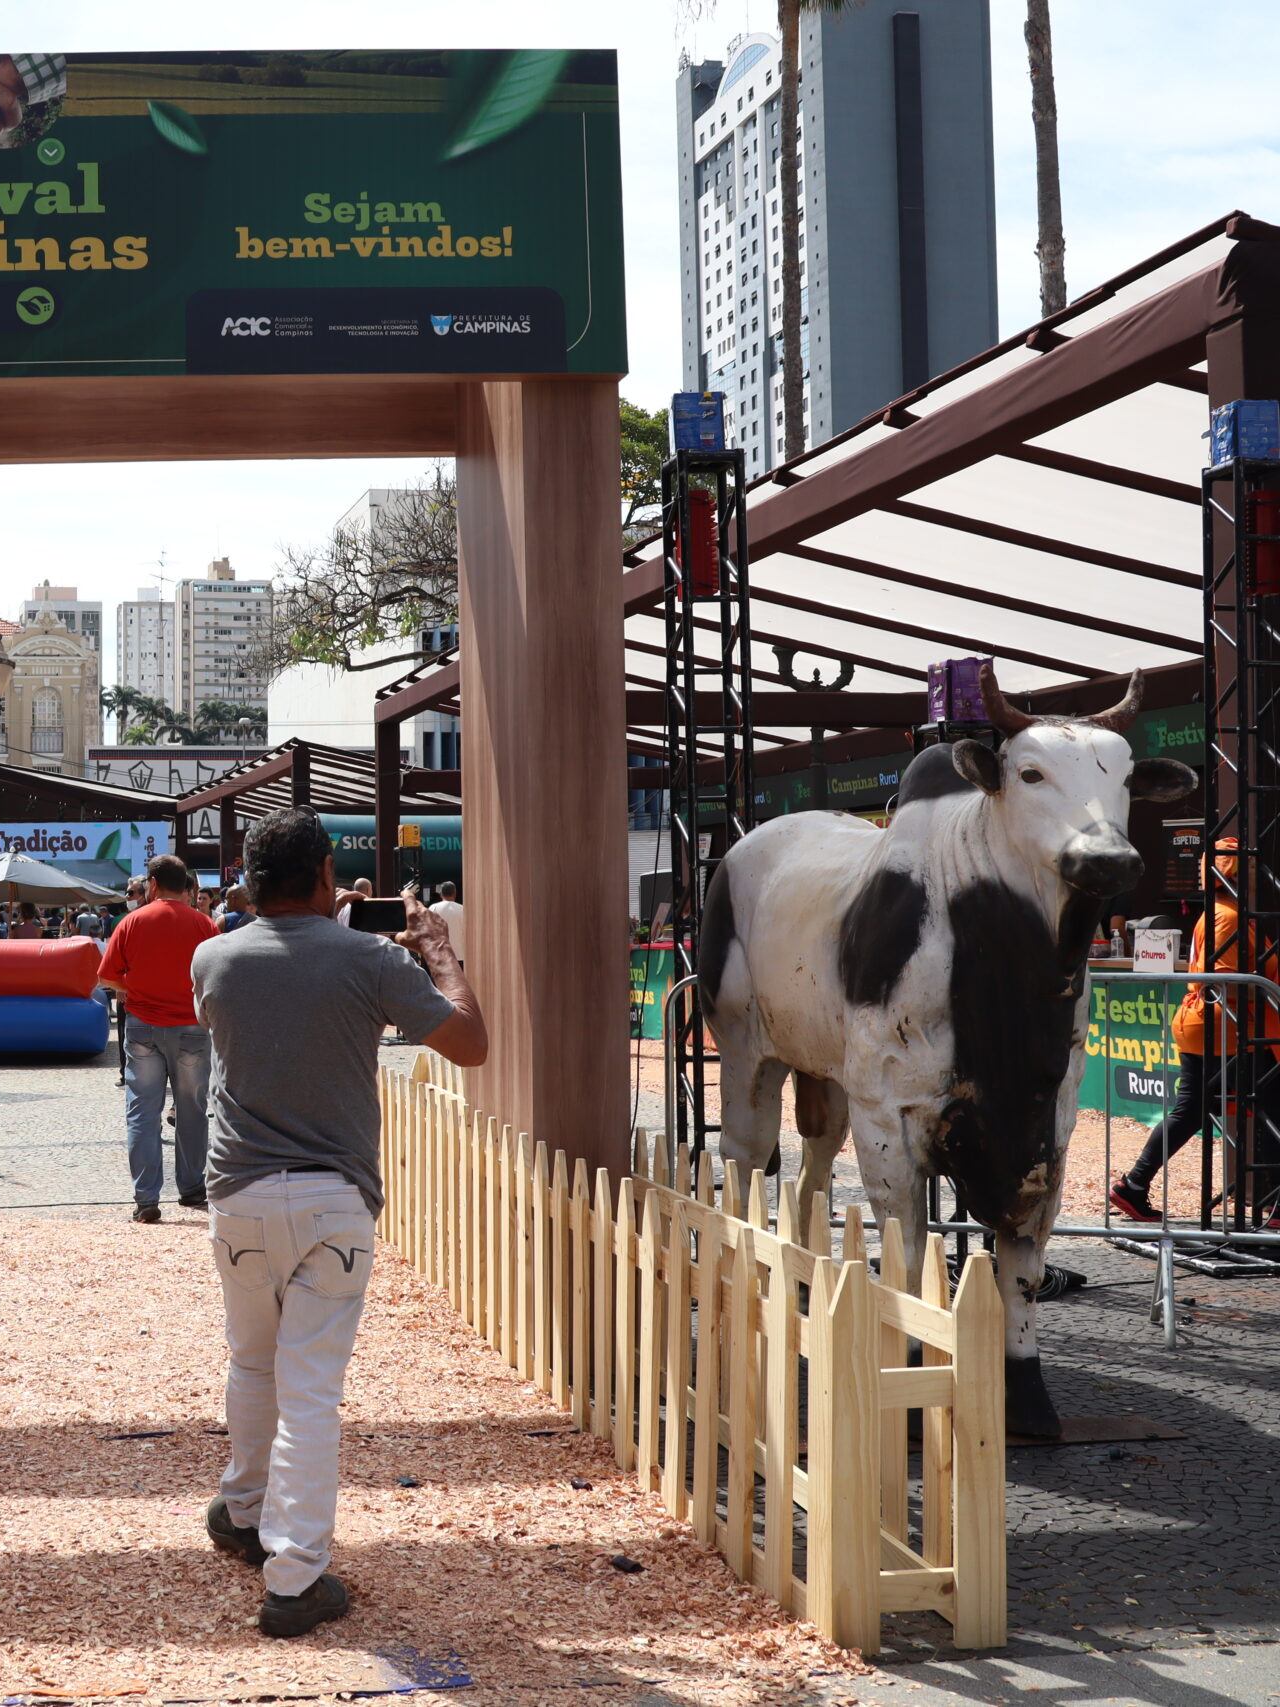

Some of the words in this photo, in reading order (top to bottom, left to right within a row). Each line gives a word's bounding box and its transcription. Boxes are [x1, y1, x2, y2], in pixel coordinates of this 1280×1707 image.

[303, 192, 446, 231] Sejam
[234, 224, 514, 260] bem-vindos!
[220, 316, 272, 337] ACIC
[274, 329, 314, 338] Campinas
[453, 321, 531, 334] CAMPINAS
[1157, 721, 1210, 749] Festiv
[831, 774, 879, 796] Campinas
[879, 770, 899, 787] Rural
[342, 835, 377, 851] SICO
[1173, 835, 1201, 846] ESPETOS
[1141, 949, 1167, 960] Churros
[1093, 987, 1180, 1025] Festiv
[1084, 1023, 1182, 1072] Campin
[1128, 1072, 1166, 1098] Rura
